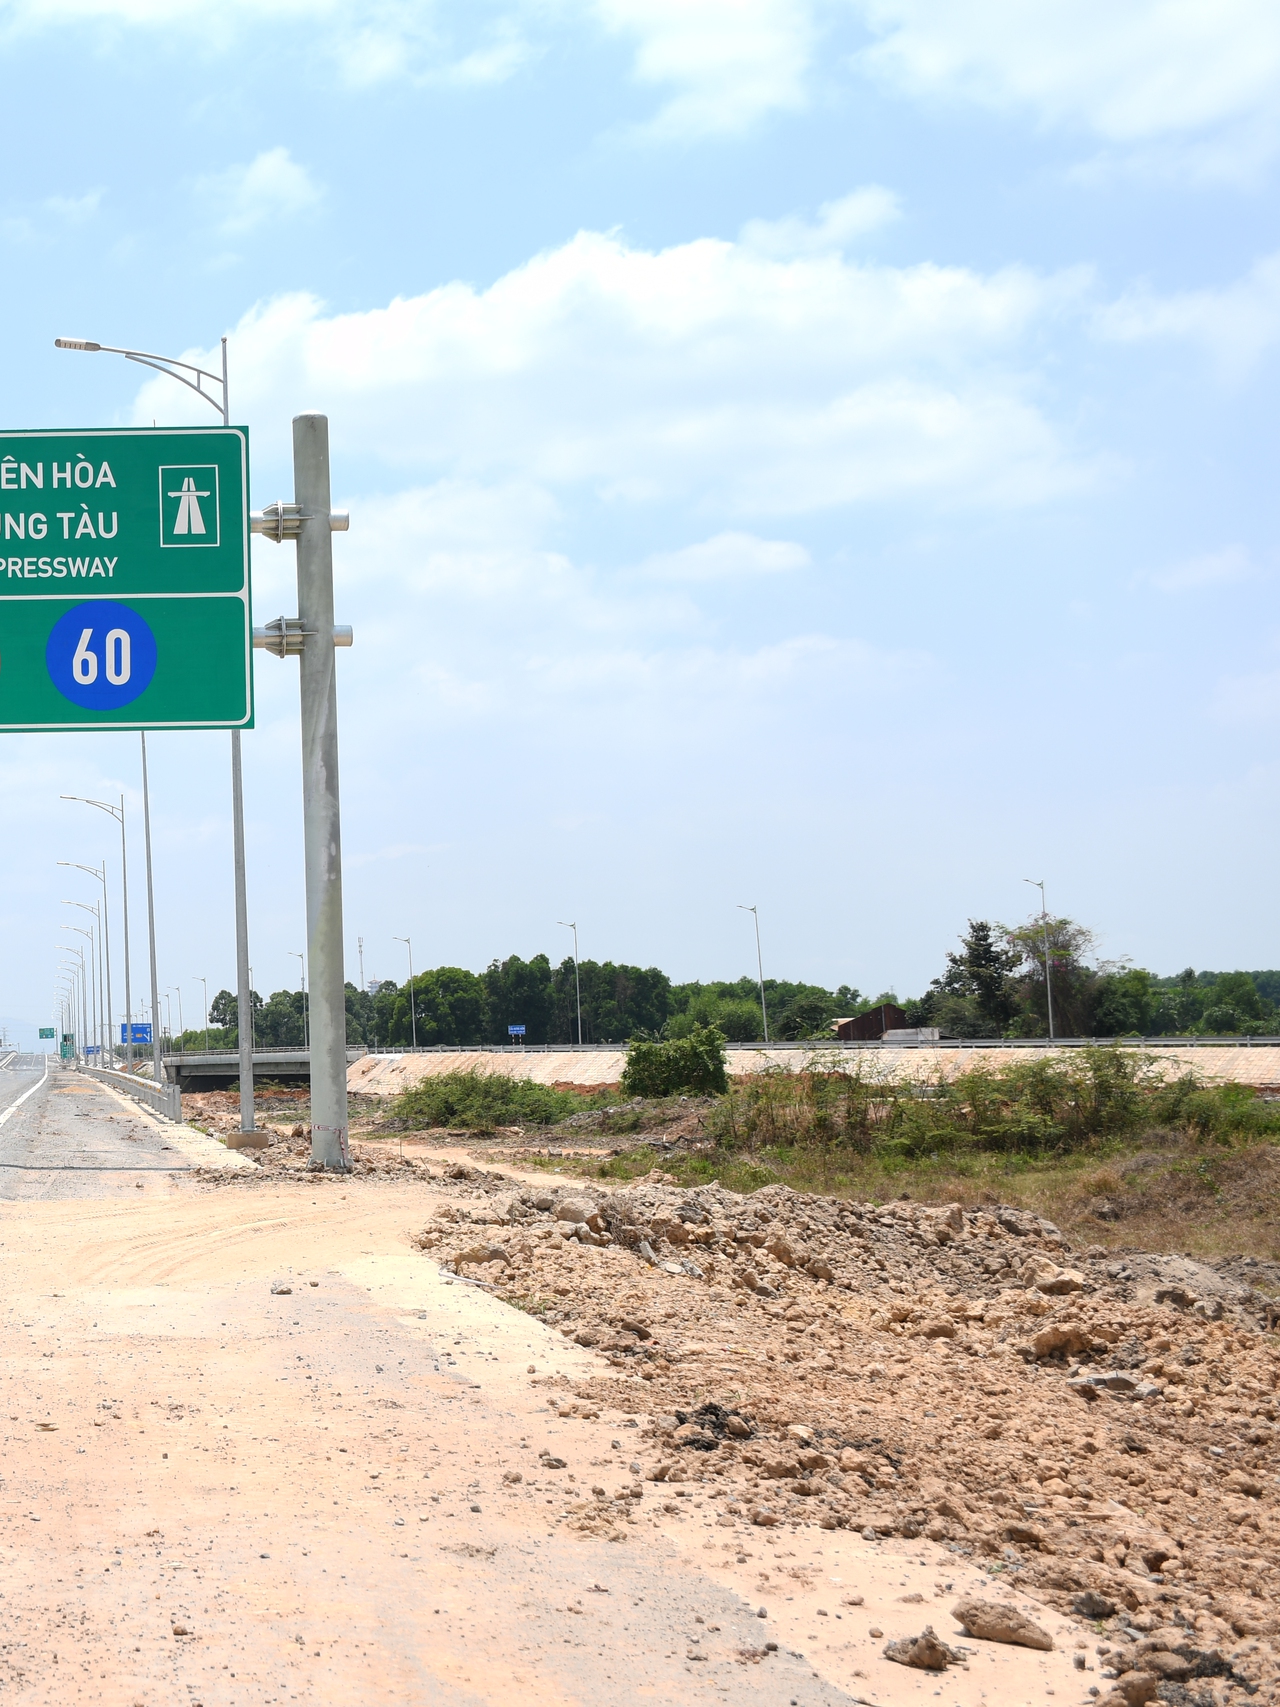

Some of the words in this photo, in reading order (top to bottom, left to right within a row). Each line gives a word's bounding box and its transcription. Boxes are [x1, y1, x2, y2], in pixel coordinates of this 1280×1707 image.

[52, 452, 117, 489] HÒA
[56, 503, 118, 540] TÀU
[72, 628, 131, 686] 60
